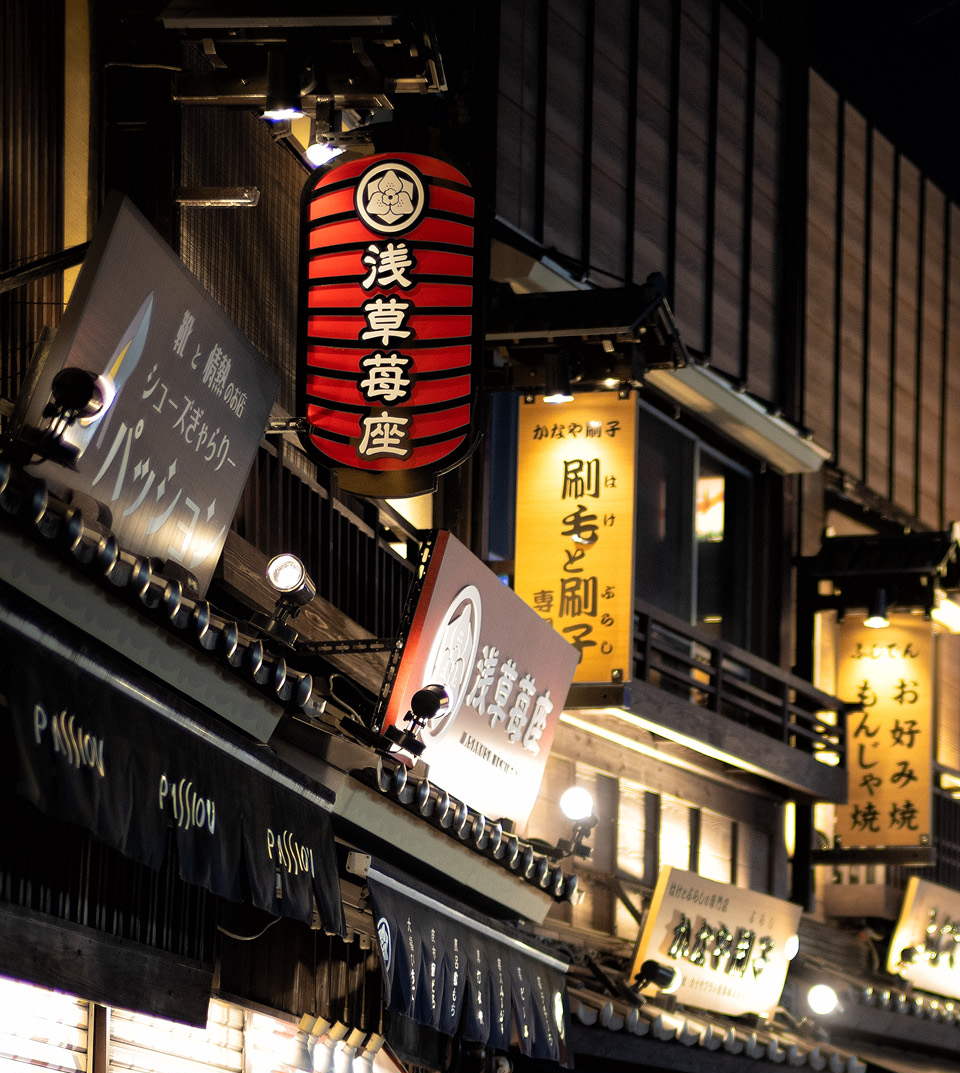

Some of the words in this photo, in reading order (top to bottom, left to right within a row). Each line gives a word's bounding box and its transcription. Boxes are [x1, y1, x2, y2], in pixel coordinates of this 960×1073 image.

[359, 243, 415, 459] 浅草苺座
[92, 418, 226, 569] パッション
[466, 645, 554, 756] 浅草苺座
[850, 679, 883, 833] もんじゃ焼
[889, 678, 921, 831] お好み焼
